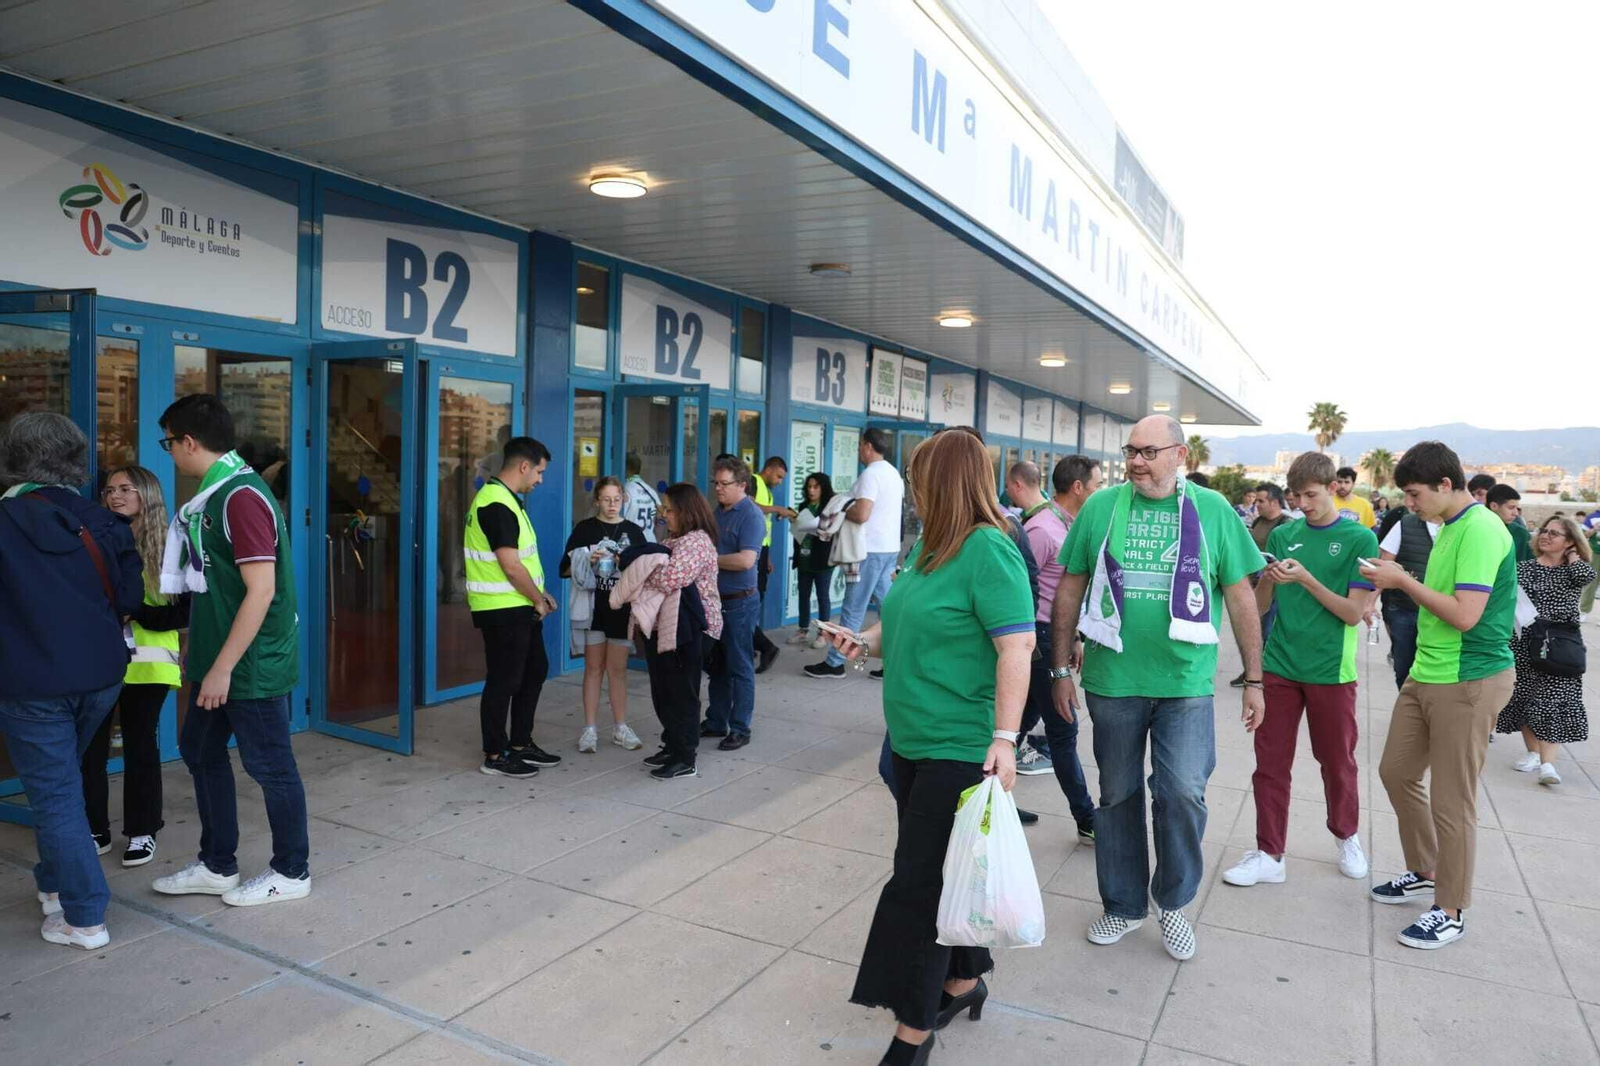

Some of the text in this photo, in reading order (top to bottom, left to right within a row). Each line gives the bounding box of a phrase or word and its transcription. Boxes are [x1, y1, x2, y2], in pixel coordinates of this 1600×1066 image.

[161, 206, 240, 240] MÁLAGA
[1009, 142, 1128, 298] MARTIN
[161, 230, 240, 258] Deporte y Eventos
[385, 237, 471, 343] B2
[327, 304, 373, 329] ACCESO
[655, 304, 704, 380] B2
[815, 347, 846, 406] B3
[1125, 538, 1166, 549] STRICT
[1127, 523, 1179, 539] ARSIT
[1124, 550, 1153, 560] NALS
[1145, 563, 1169, 571] FIELD
[1124, 591, 1169, 601] IRST PLAC
